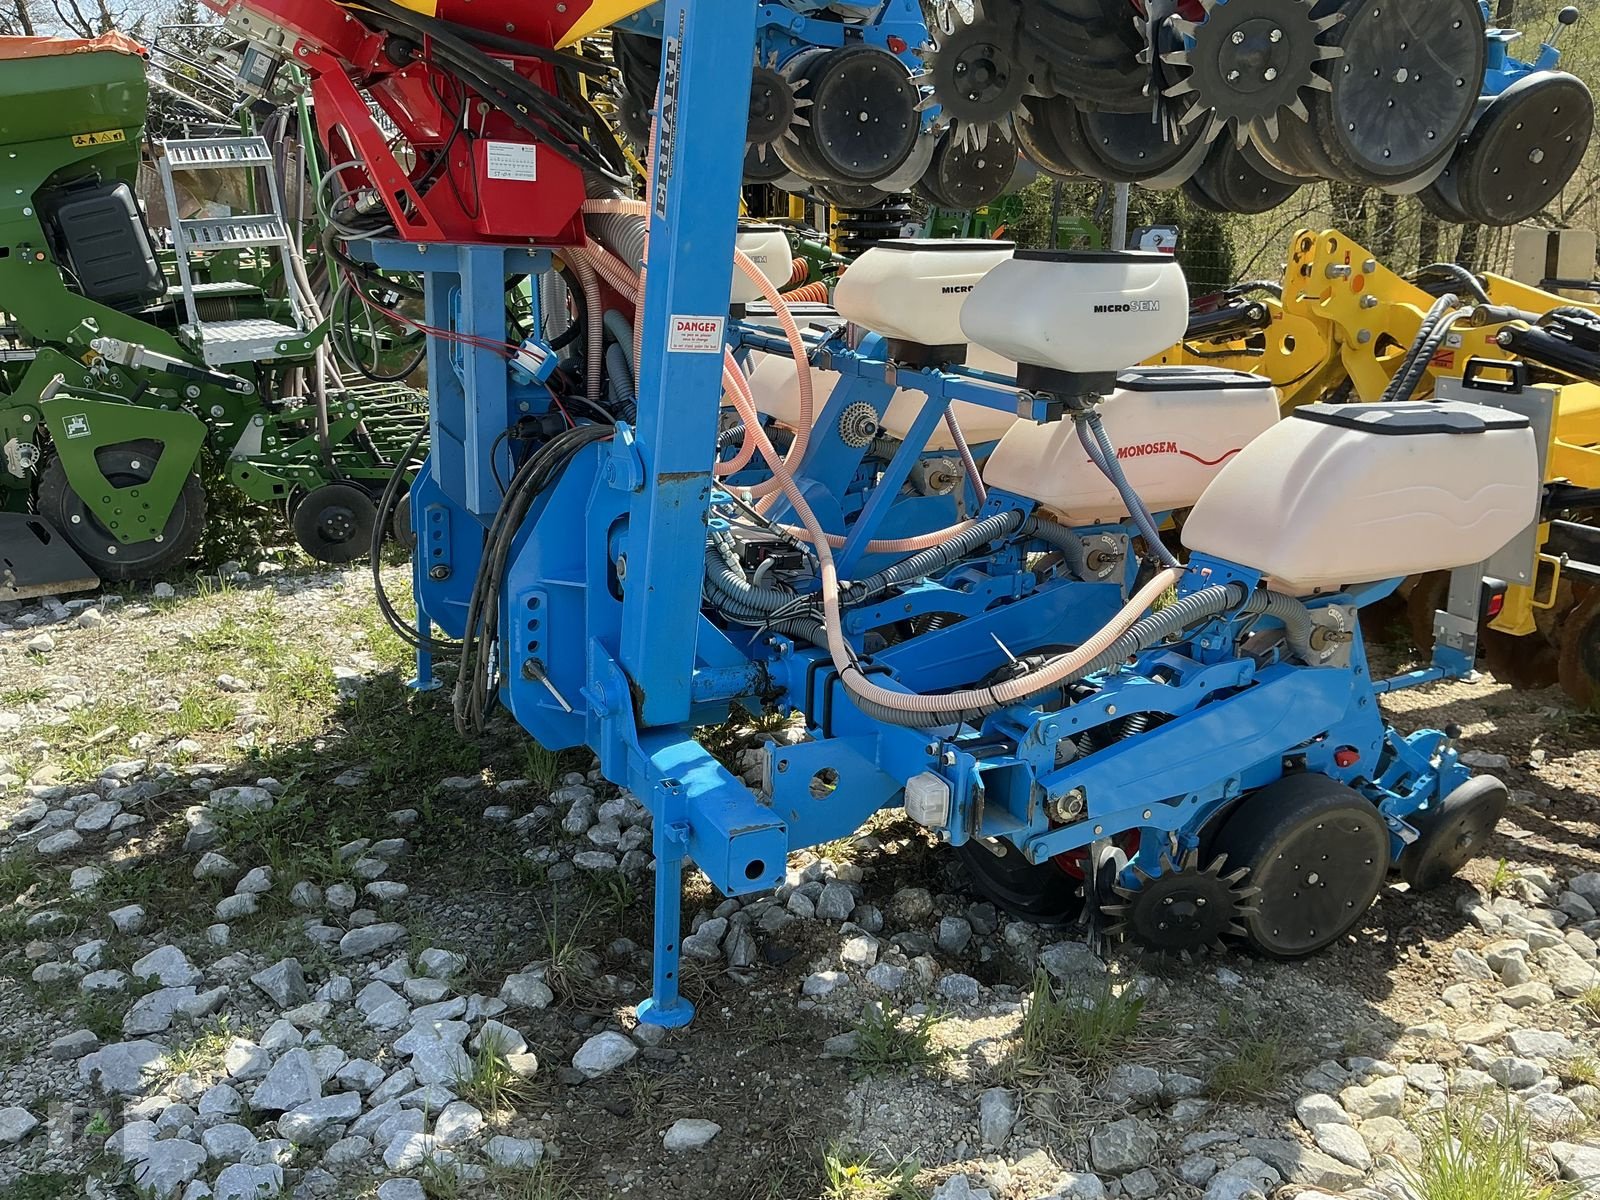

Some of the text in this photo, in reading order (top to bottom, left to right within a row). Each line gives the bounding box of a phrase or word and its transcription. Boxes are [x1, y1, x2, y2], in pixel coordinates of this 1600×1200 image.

[656, 41, 677, 214] ERHART
[677, 321, 717, 332] DANGER
[1116, 441, 1178, 459] MONOSEM
